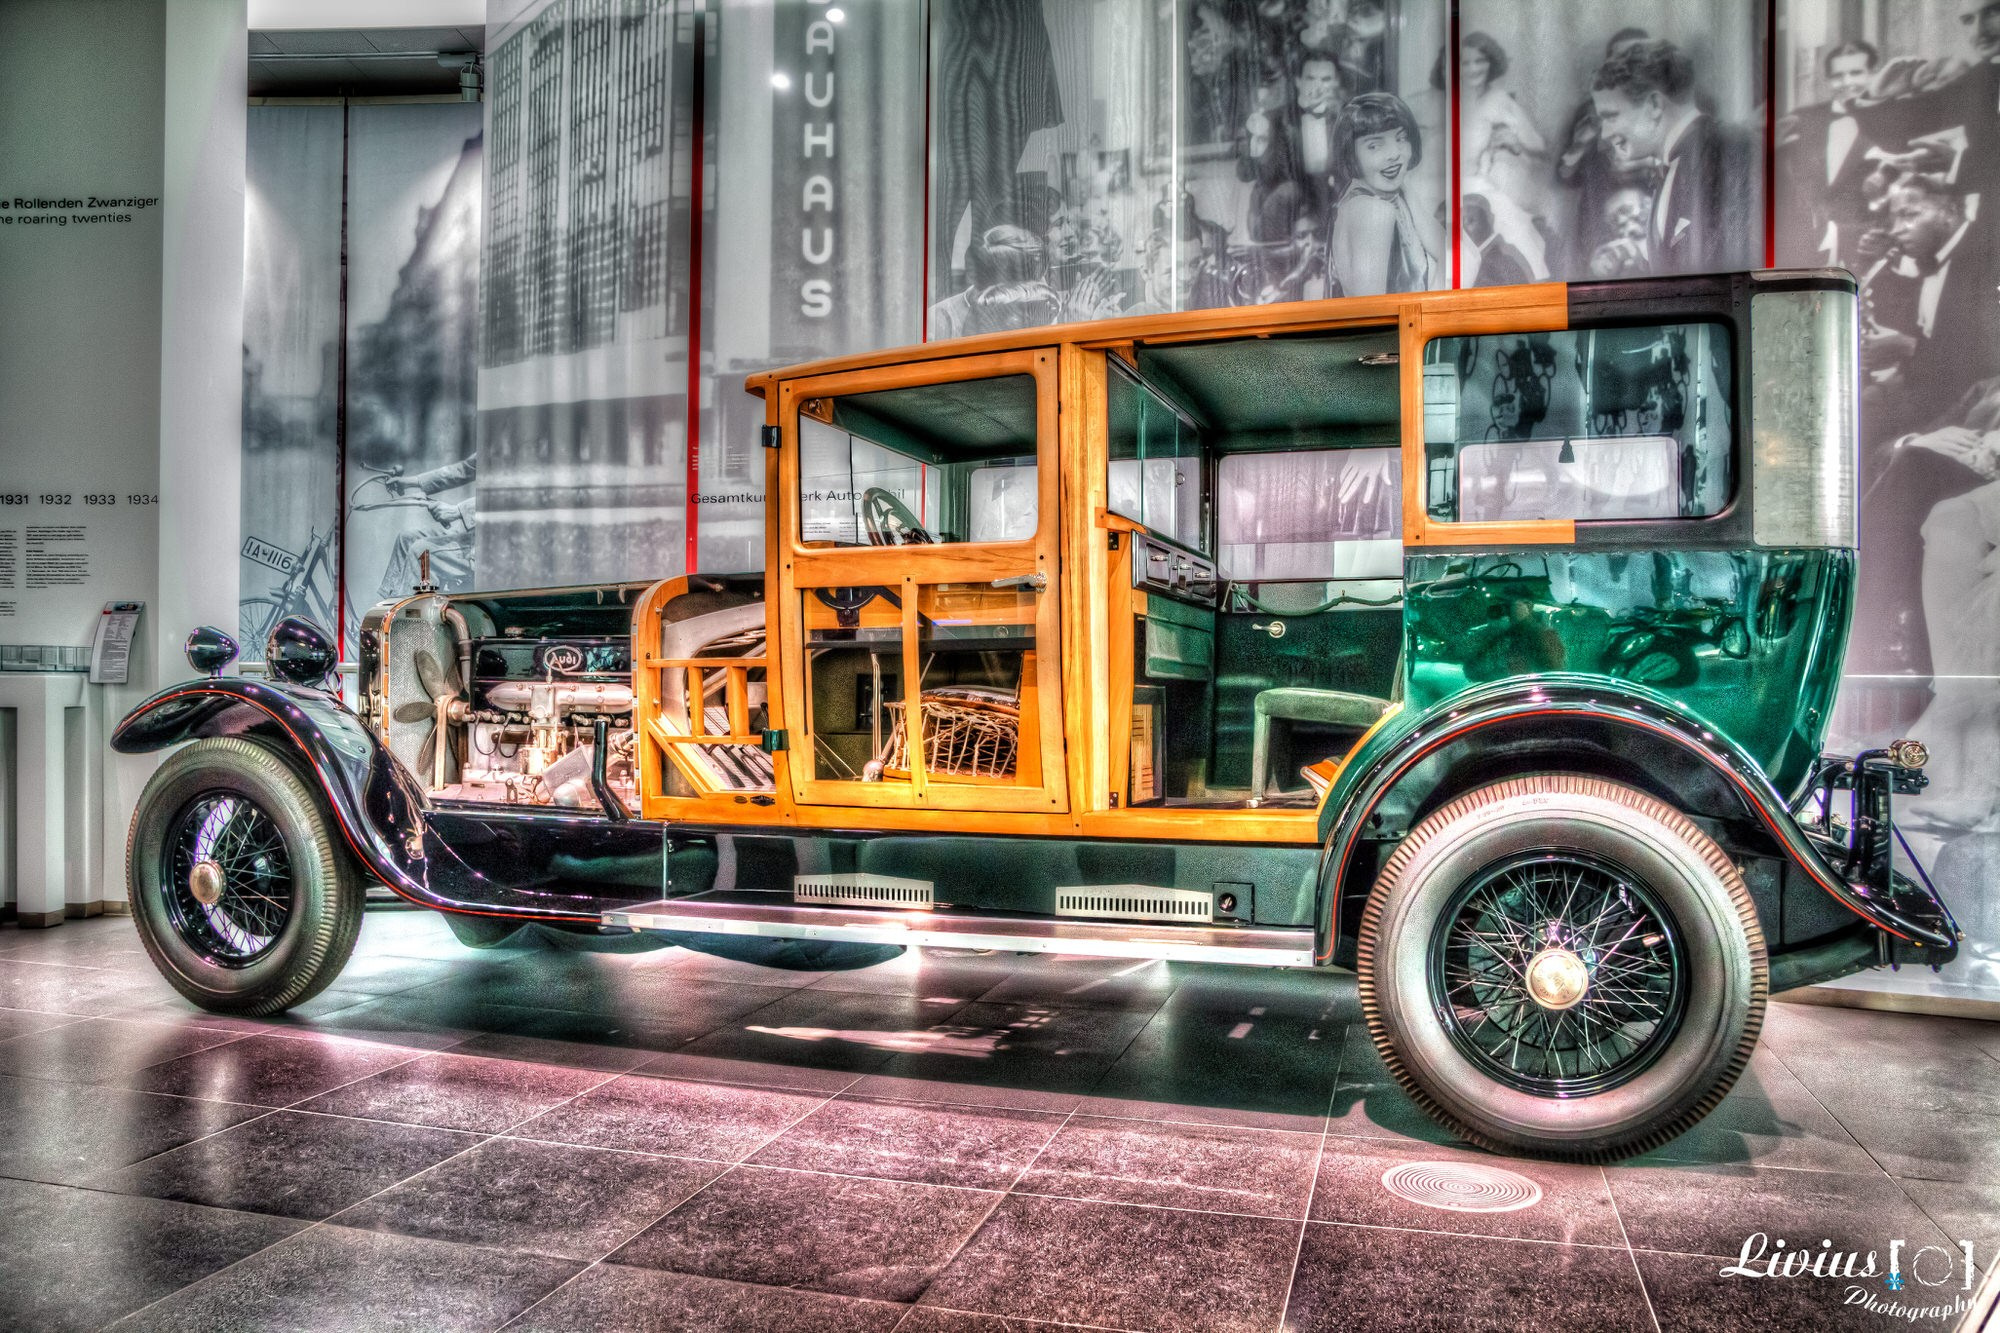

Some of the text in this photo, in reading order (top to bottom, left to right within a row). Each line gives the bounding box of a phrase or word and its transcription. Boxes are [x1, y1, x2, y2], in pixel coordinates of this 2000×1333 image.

[801, 0, 834, 318] AUHAUS
[14, 198, 83, 210] Rollenden
[88, 196, 159, 210] Zwanziger
[18, 213, 67, 227] roaring
[72, 212, 132, 224] twenties
[0, 494, 158, 505] 1931 1932 1933 1934
[551, 652, 576, 665] Audi
